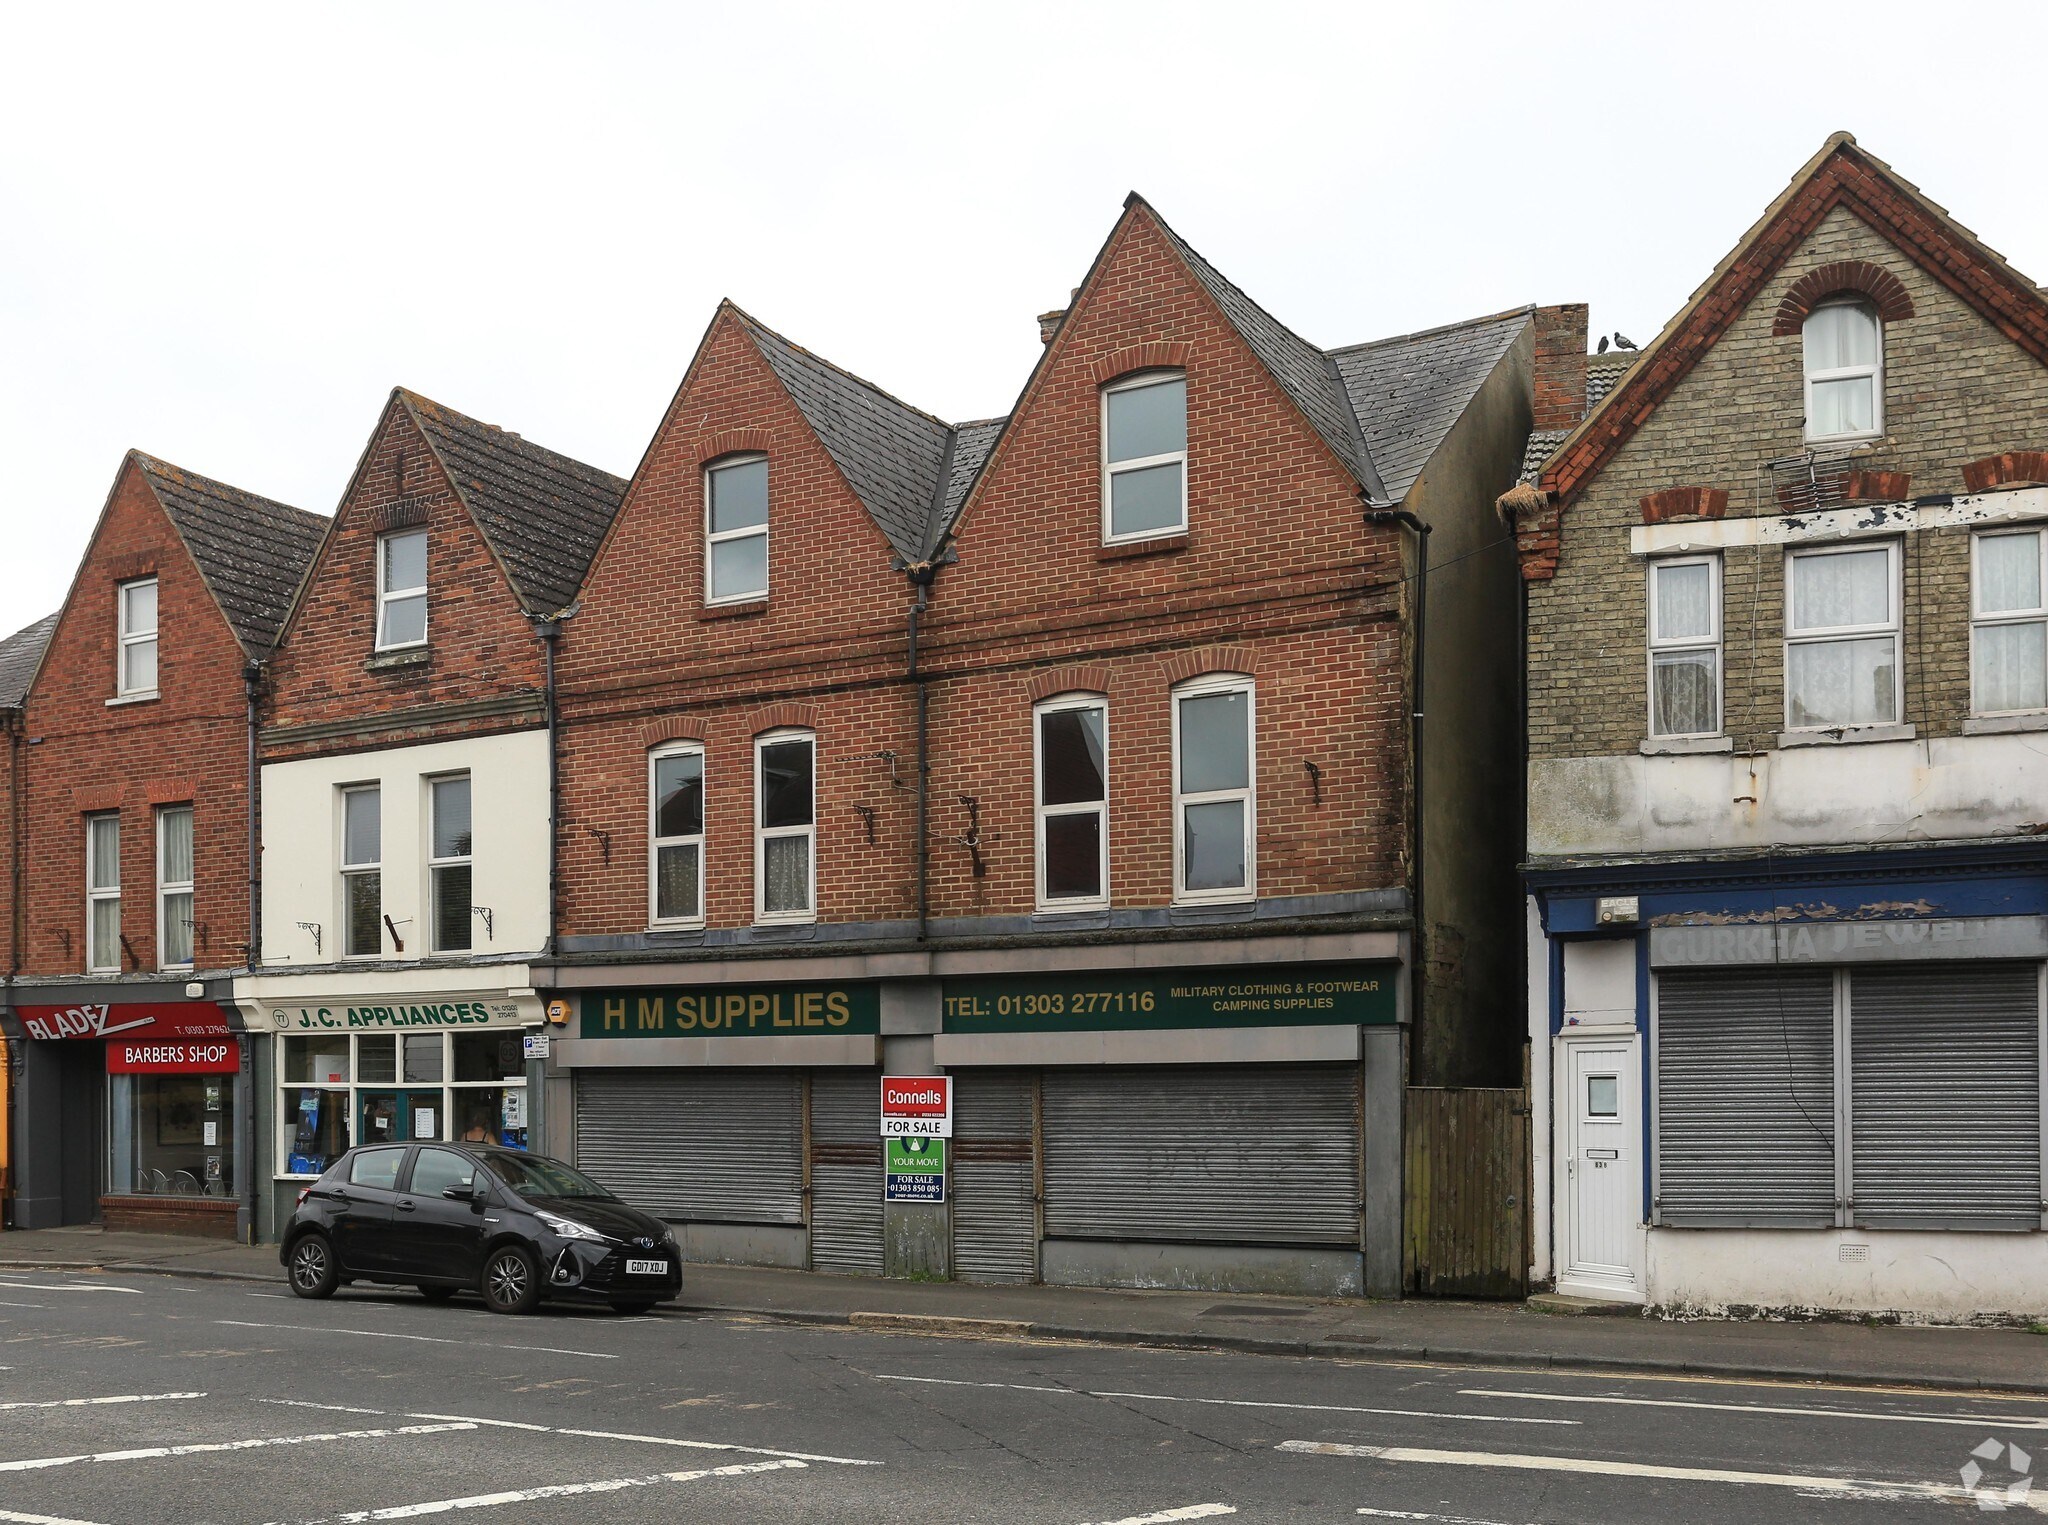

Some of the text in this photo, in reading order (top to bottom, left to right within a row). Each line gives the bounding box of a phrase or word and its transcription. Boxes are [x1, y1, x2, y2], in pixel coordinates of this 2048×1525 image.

[1660, 926, 1818, 963] GURKHA
[1171, 980, 1379, 998] MILITARY CLOTHING & FOOTWEAR
[676, 991, 850, 1029] SUPPLIES
[944, 991, 1155, 1017] TEL: 01303 277116
[1213, 998, 1334, 1012] CAMPING SUPPLIES
[25, 1004, 155, 1040] BLADEZ
[275, 1014, 285, 1023] 77
[347, 1002, 489, 1027] APPLIANCES
[185, 1026, 205, 1035] 01303
[125, 1046, 227, 1063] BARBERS SHOP
[888, 1089, 941, 1105] Connells
[887, 1121, 941, 1133] FOR SALE
[893, 1157, 939, 1166] YOUR MOVE
[897, 1175, 934, 1184] FOR SALE
[912, 1184, 925, 1192] 850
[631, 1261, 664, 1273] GD17 XDJ
